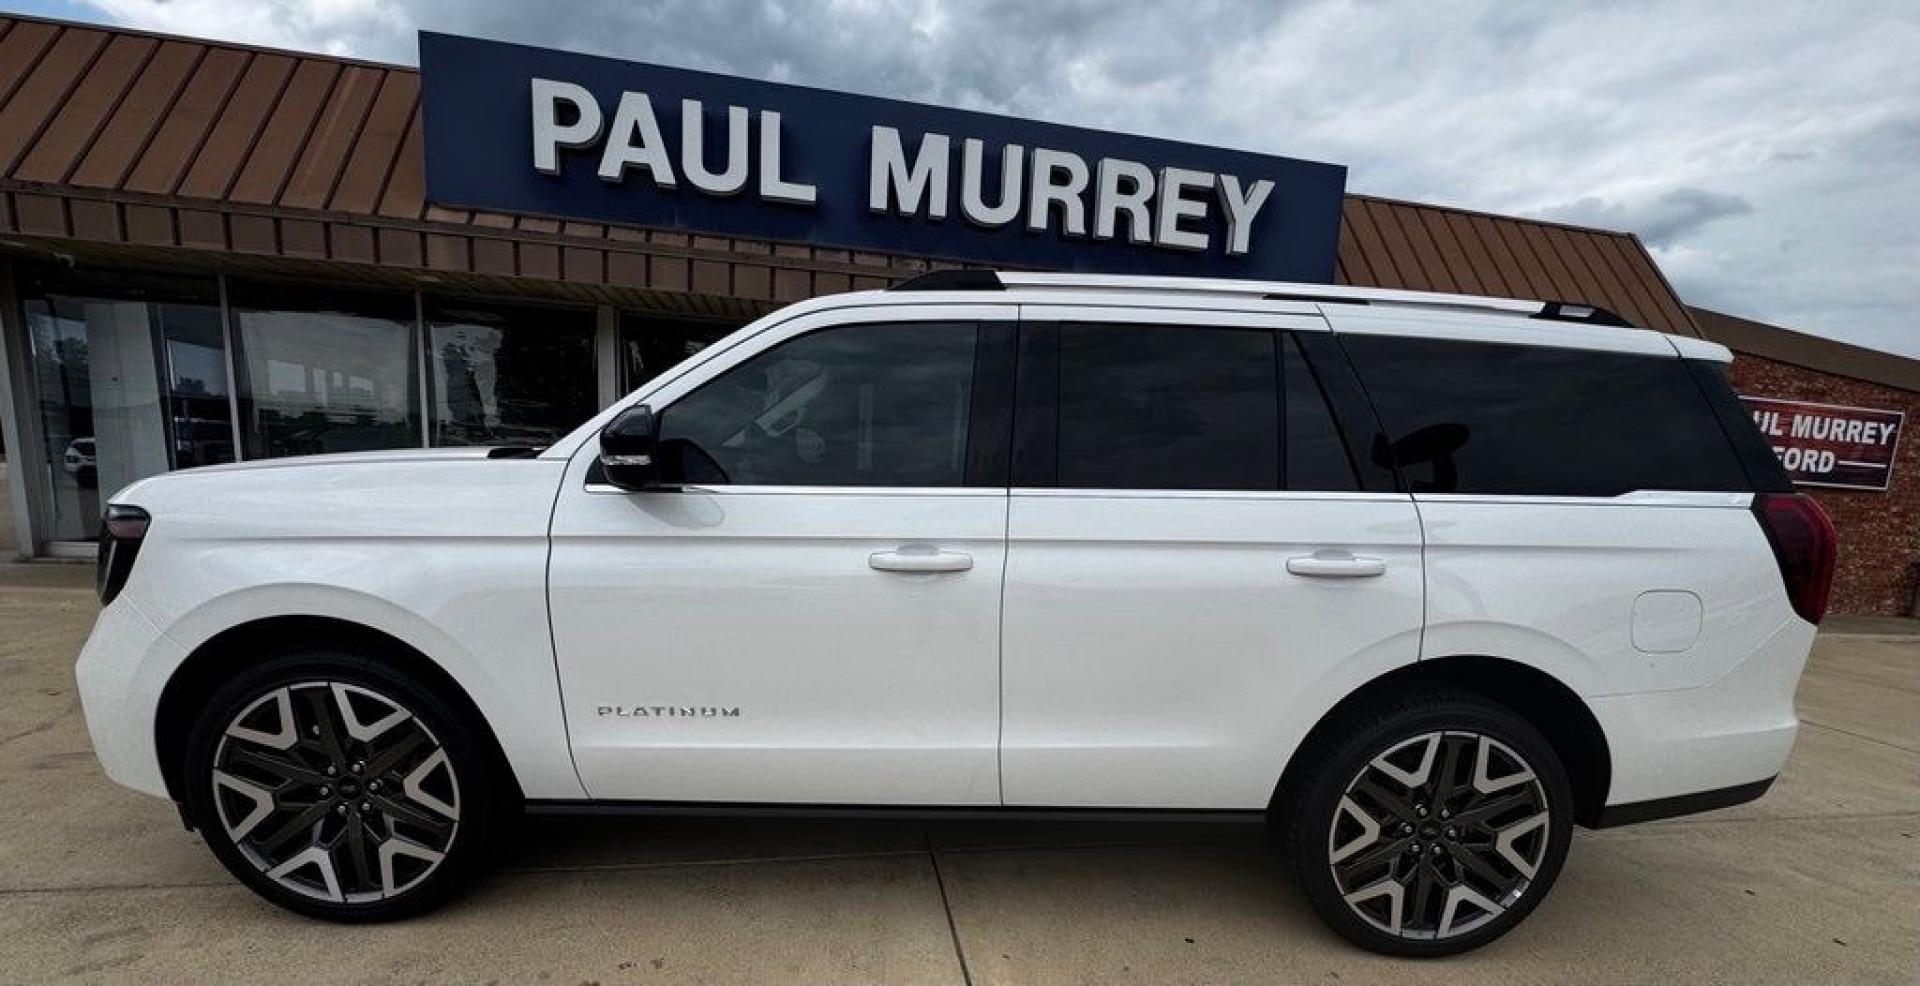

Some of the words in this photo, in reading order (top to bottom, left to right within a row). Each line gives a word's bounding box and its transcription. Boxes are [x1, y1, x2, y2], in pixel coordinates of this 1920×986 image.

[530, 77, 817, 203] PAUL
[869, 125, 1276, 255] MURREY
[1753, 410, 1783, 436] UL
[1791, 414, 1896, 445] MURREY
[596, 705, 741, 717] PLATINUM
